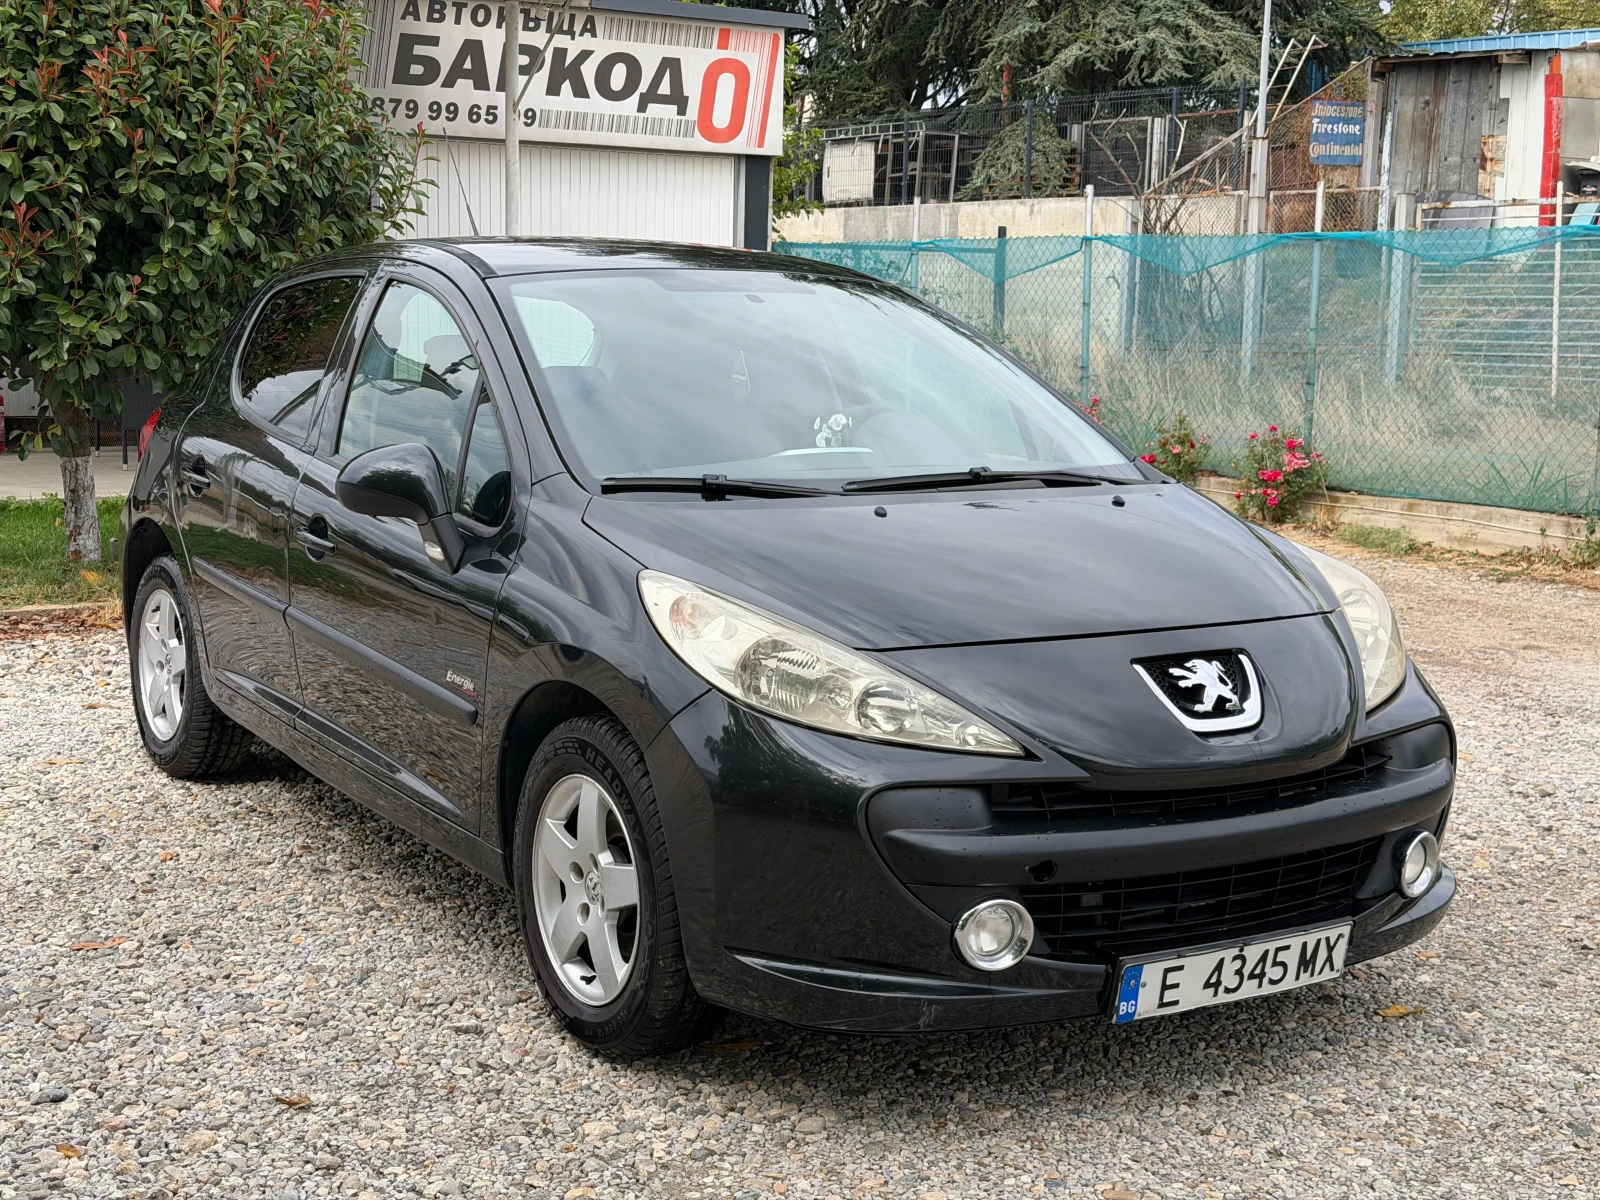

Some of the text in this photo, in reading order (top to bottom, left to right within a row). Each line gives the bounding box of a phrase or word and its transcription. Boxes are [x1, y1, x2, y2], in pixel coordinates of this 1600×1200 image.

[362, 95, 419, 120] 879
[427, 100, 459, 122] 99
[467, 103, 498, 125] 65
[1311, 117, 1361, 135] Firestone
[1308, 142, 1363, 157] Continental
[1157, 932, 1347, 1010] E 4345 MX
[1118, 1000, 1136, 1016] BG
